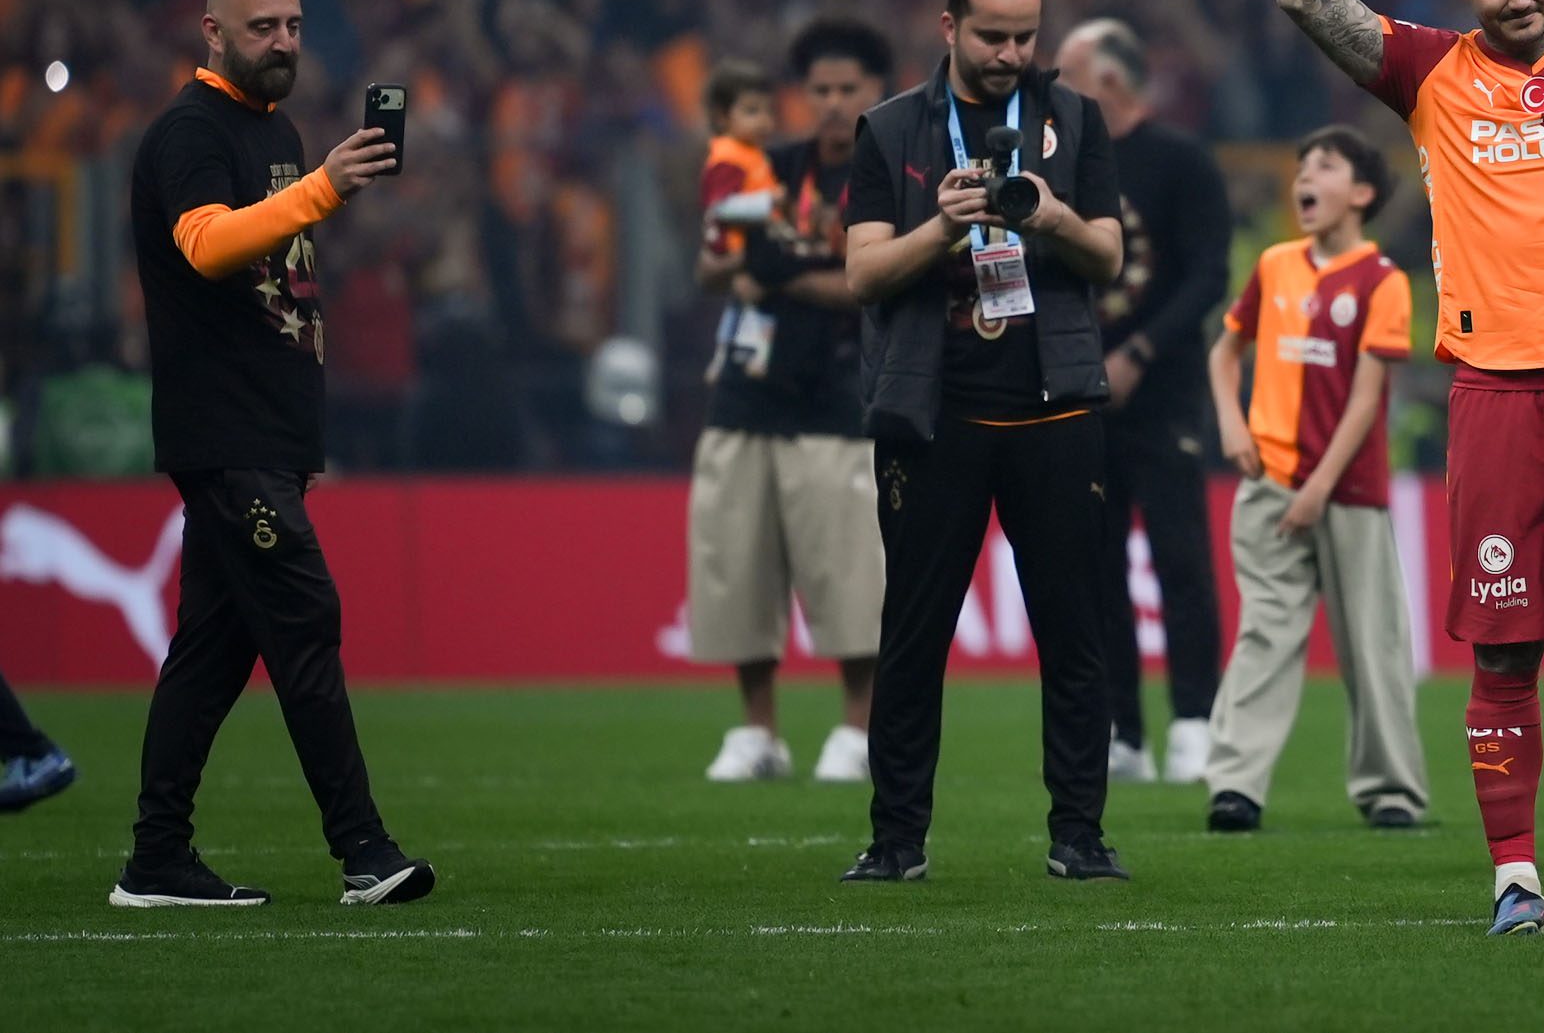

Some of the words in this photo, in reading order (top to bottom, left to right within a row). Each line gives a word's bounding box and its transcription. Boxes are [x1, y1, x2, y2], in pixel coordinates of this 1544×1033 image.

[1471, 576, 1527, 604] Lydia
[1496, 597, 1529, 610] Holding
[1475, 742, 1500, 754] GS
